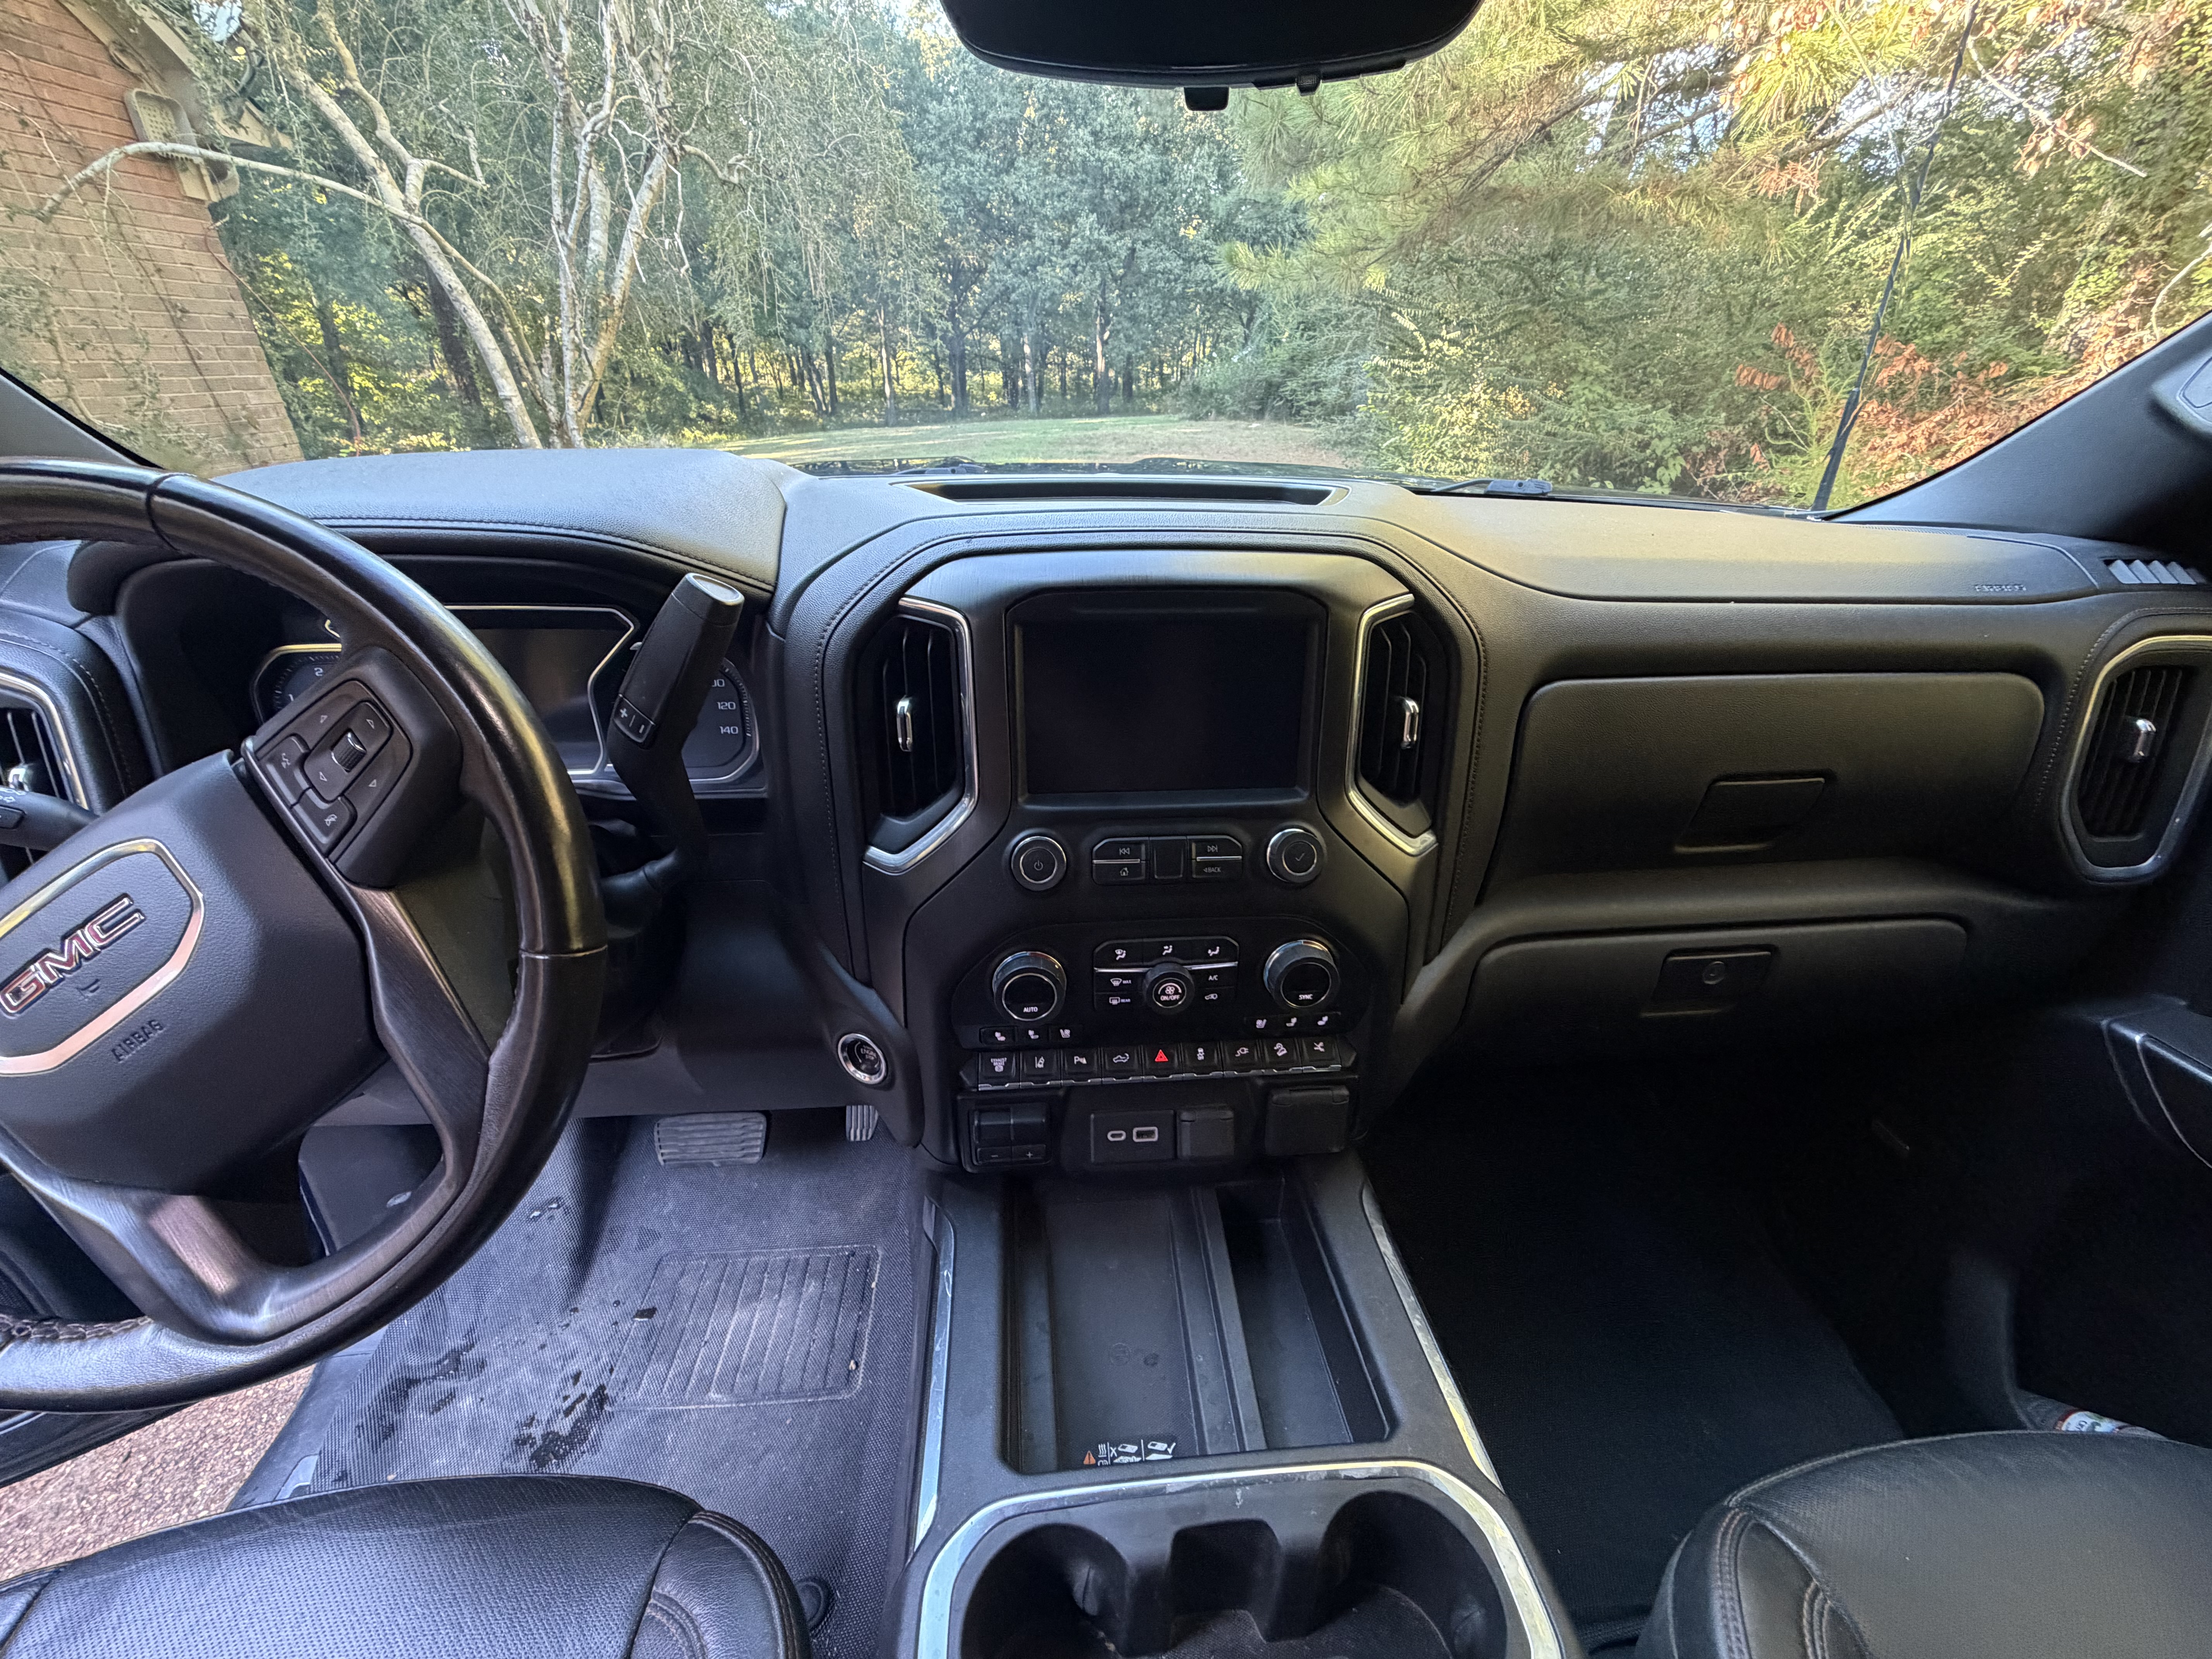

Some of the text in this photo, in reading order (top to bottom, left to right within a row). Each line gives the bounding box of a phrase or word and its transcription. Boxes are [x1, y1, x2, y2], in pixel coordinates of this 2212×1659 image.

[314, 667, 323, 677] 2
[716, 701, 736, 710] 120
[719, 726, 738, 734] 140
[0, 896, 145, 1014] GMC
